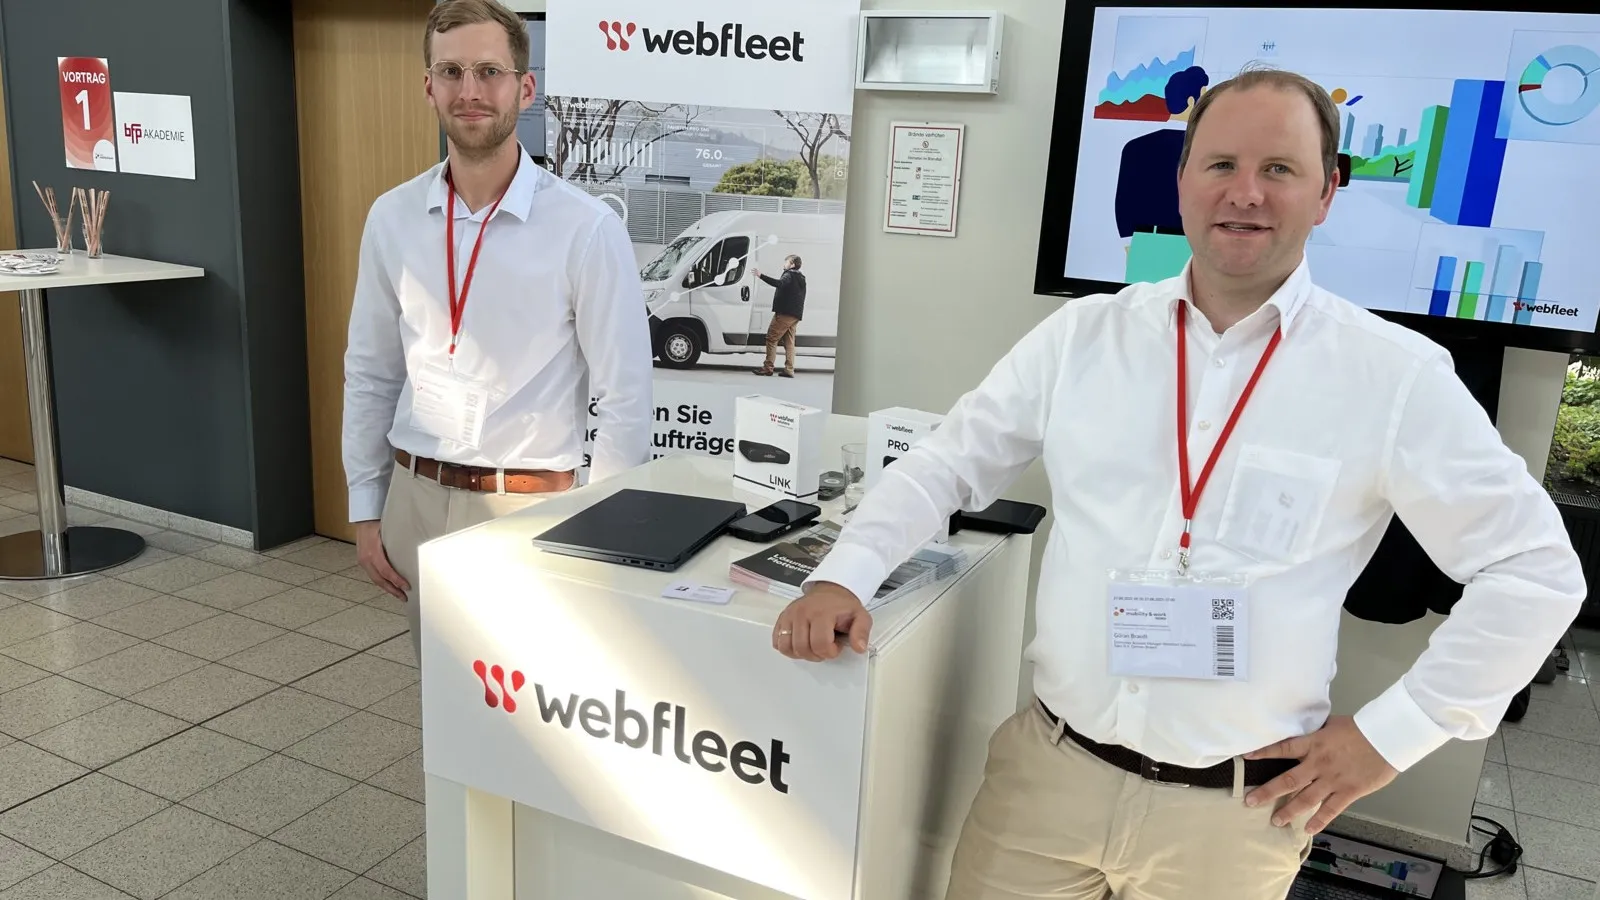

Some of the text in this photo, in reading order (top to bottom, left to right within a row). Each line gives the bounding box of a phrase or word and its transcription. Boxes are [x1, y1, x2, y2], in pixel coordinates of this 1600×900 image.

[642, 21, 804, 62] webfleet
[62, 71, 106, 84] VORTRAG
[75, 89, 91, 131] 1
[124, 122, 185, 144] bfp AKADEMIE
[695, 148, 722, 160] 76.0
[1526, 303, 1579, 317] webfleet
[677, 404, 713, 425] Sie
[891, 425, 913, 433] webfleet
[651, 429, 734, 455] ufträge
[888, 439, 910, 452] PRO
[770, 474, 791, 490] LINK
[534, 683, 791, 795] webfleet
